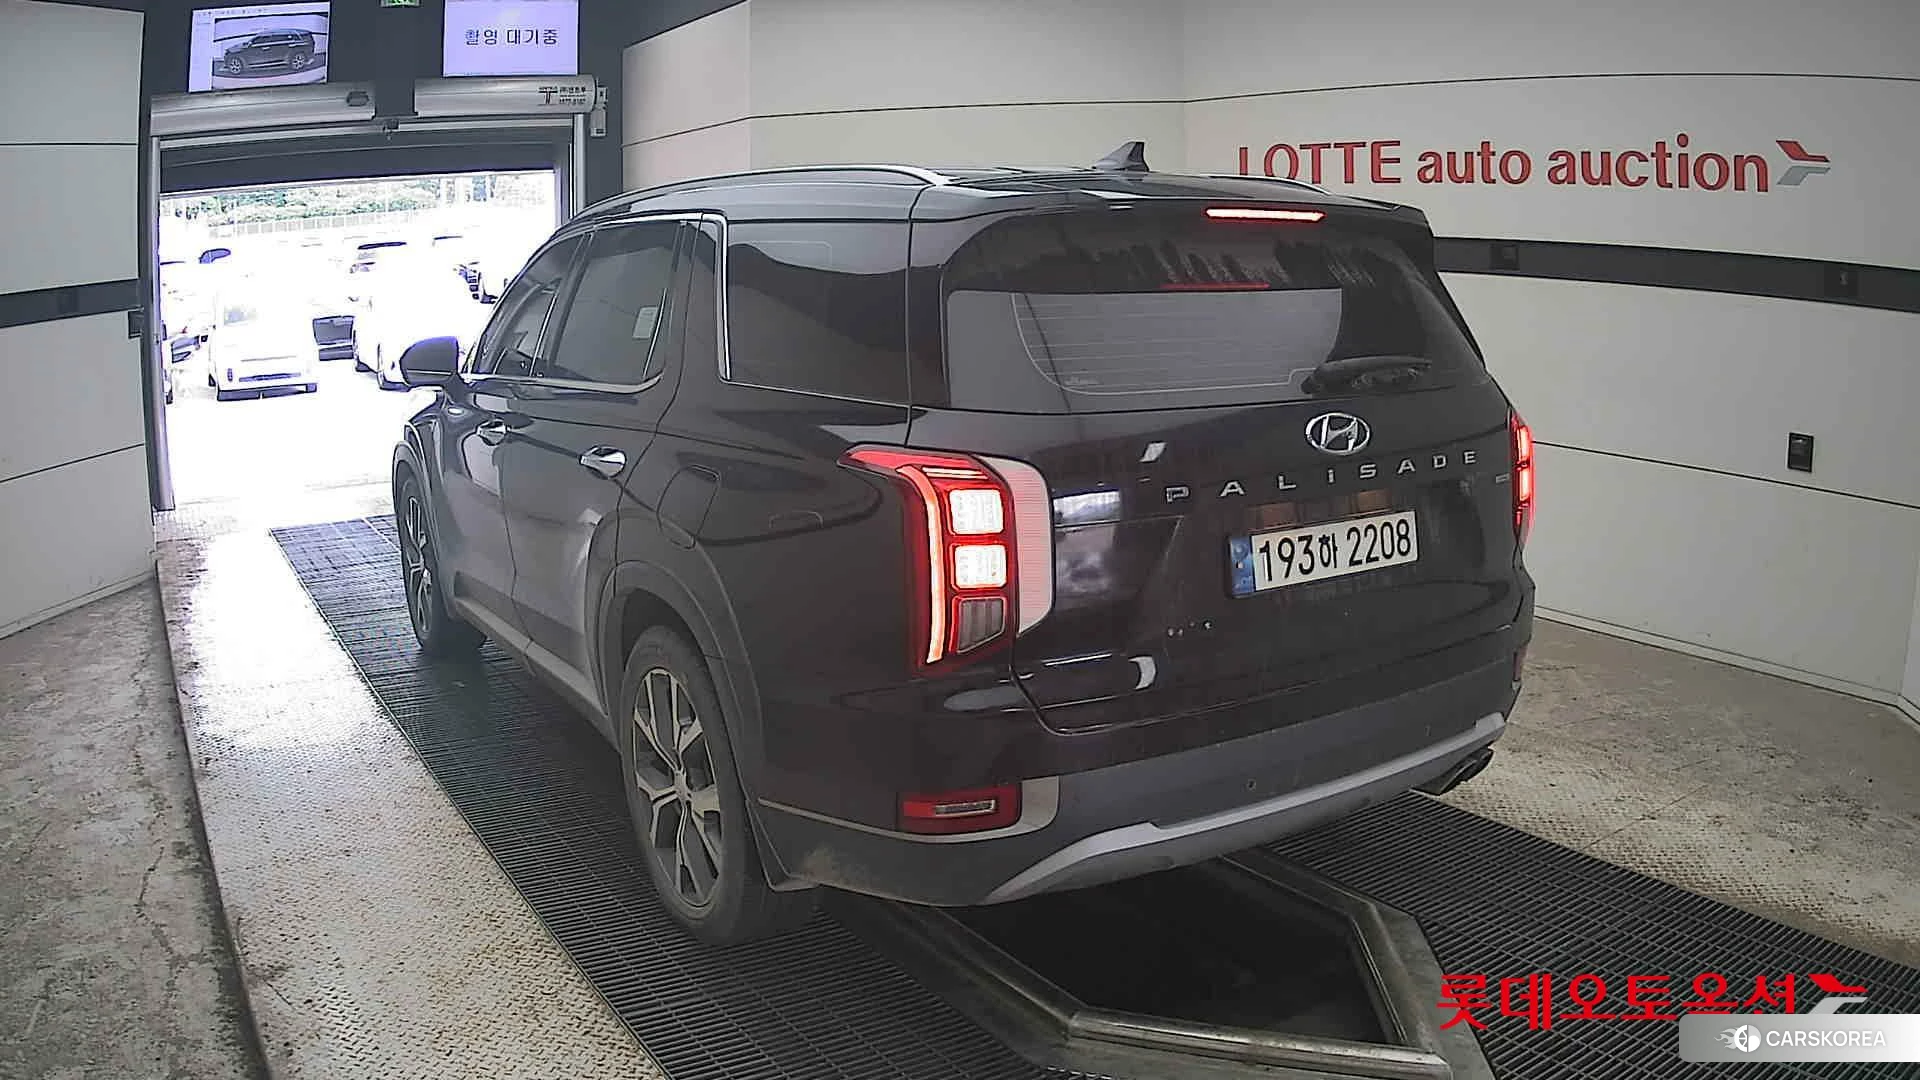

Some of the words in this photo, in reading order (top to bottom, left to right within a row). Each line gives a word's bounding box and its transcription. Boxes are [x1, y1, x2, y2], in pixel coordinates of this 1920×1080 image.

[506, 28, 558, 46] 대기중
[1416, 140, 1533, 184] auto
[1547, 133, 1769, 192] auction
[1165, 450, 1478, 503] PALISADE
[1258, 532, 1340, 582] 193하
[1346, 518, 1413, 567] 2208
